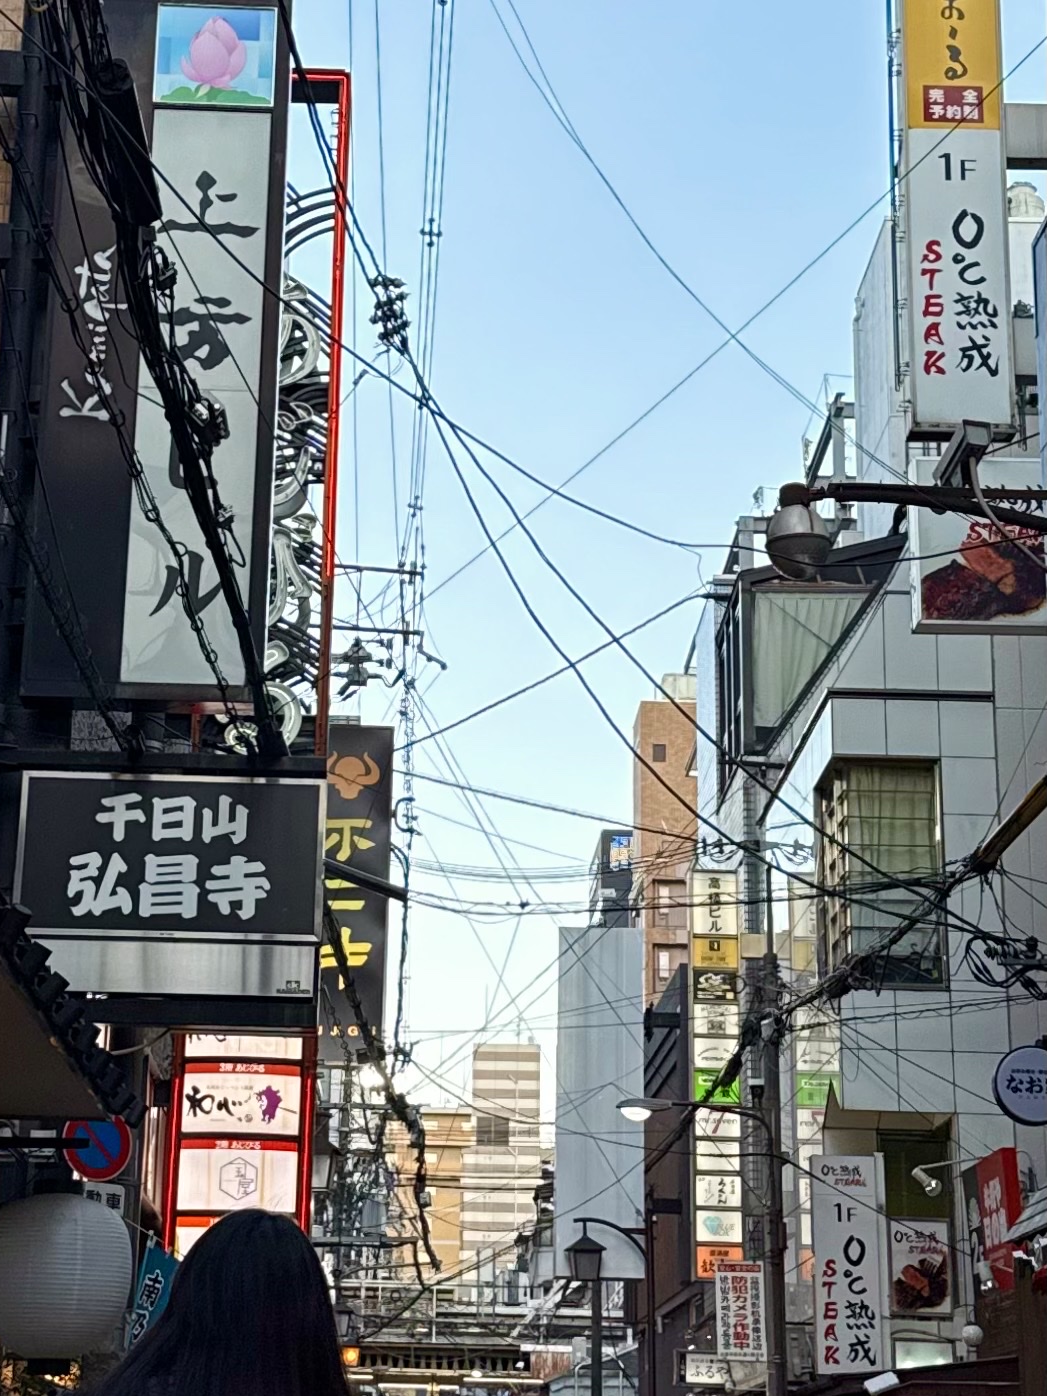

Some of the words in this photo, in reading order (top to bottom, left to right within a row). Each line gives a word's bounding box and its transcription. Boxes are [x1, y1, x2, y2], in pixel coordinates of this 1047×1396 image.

[929, 89, 978, 103] 完全
[938, 153, 977, 181] 1F
[920, 239, 946, 376] STEAK
[95, 792, 250, 845] 千日山
[66, 850, 271, 921] 弘昌寺
[1005, 1074, 1047, 1094] なお
[833, 1203, 858, 1222] 1F
[730, 1276, 750, 1350] 防犯カメラ作動中
[822, 1258, 840, 1365] STEAK
